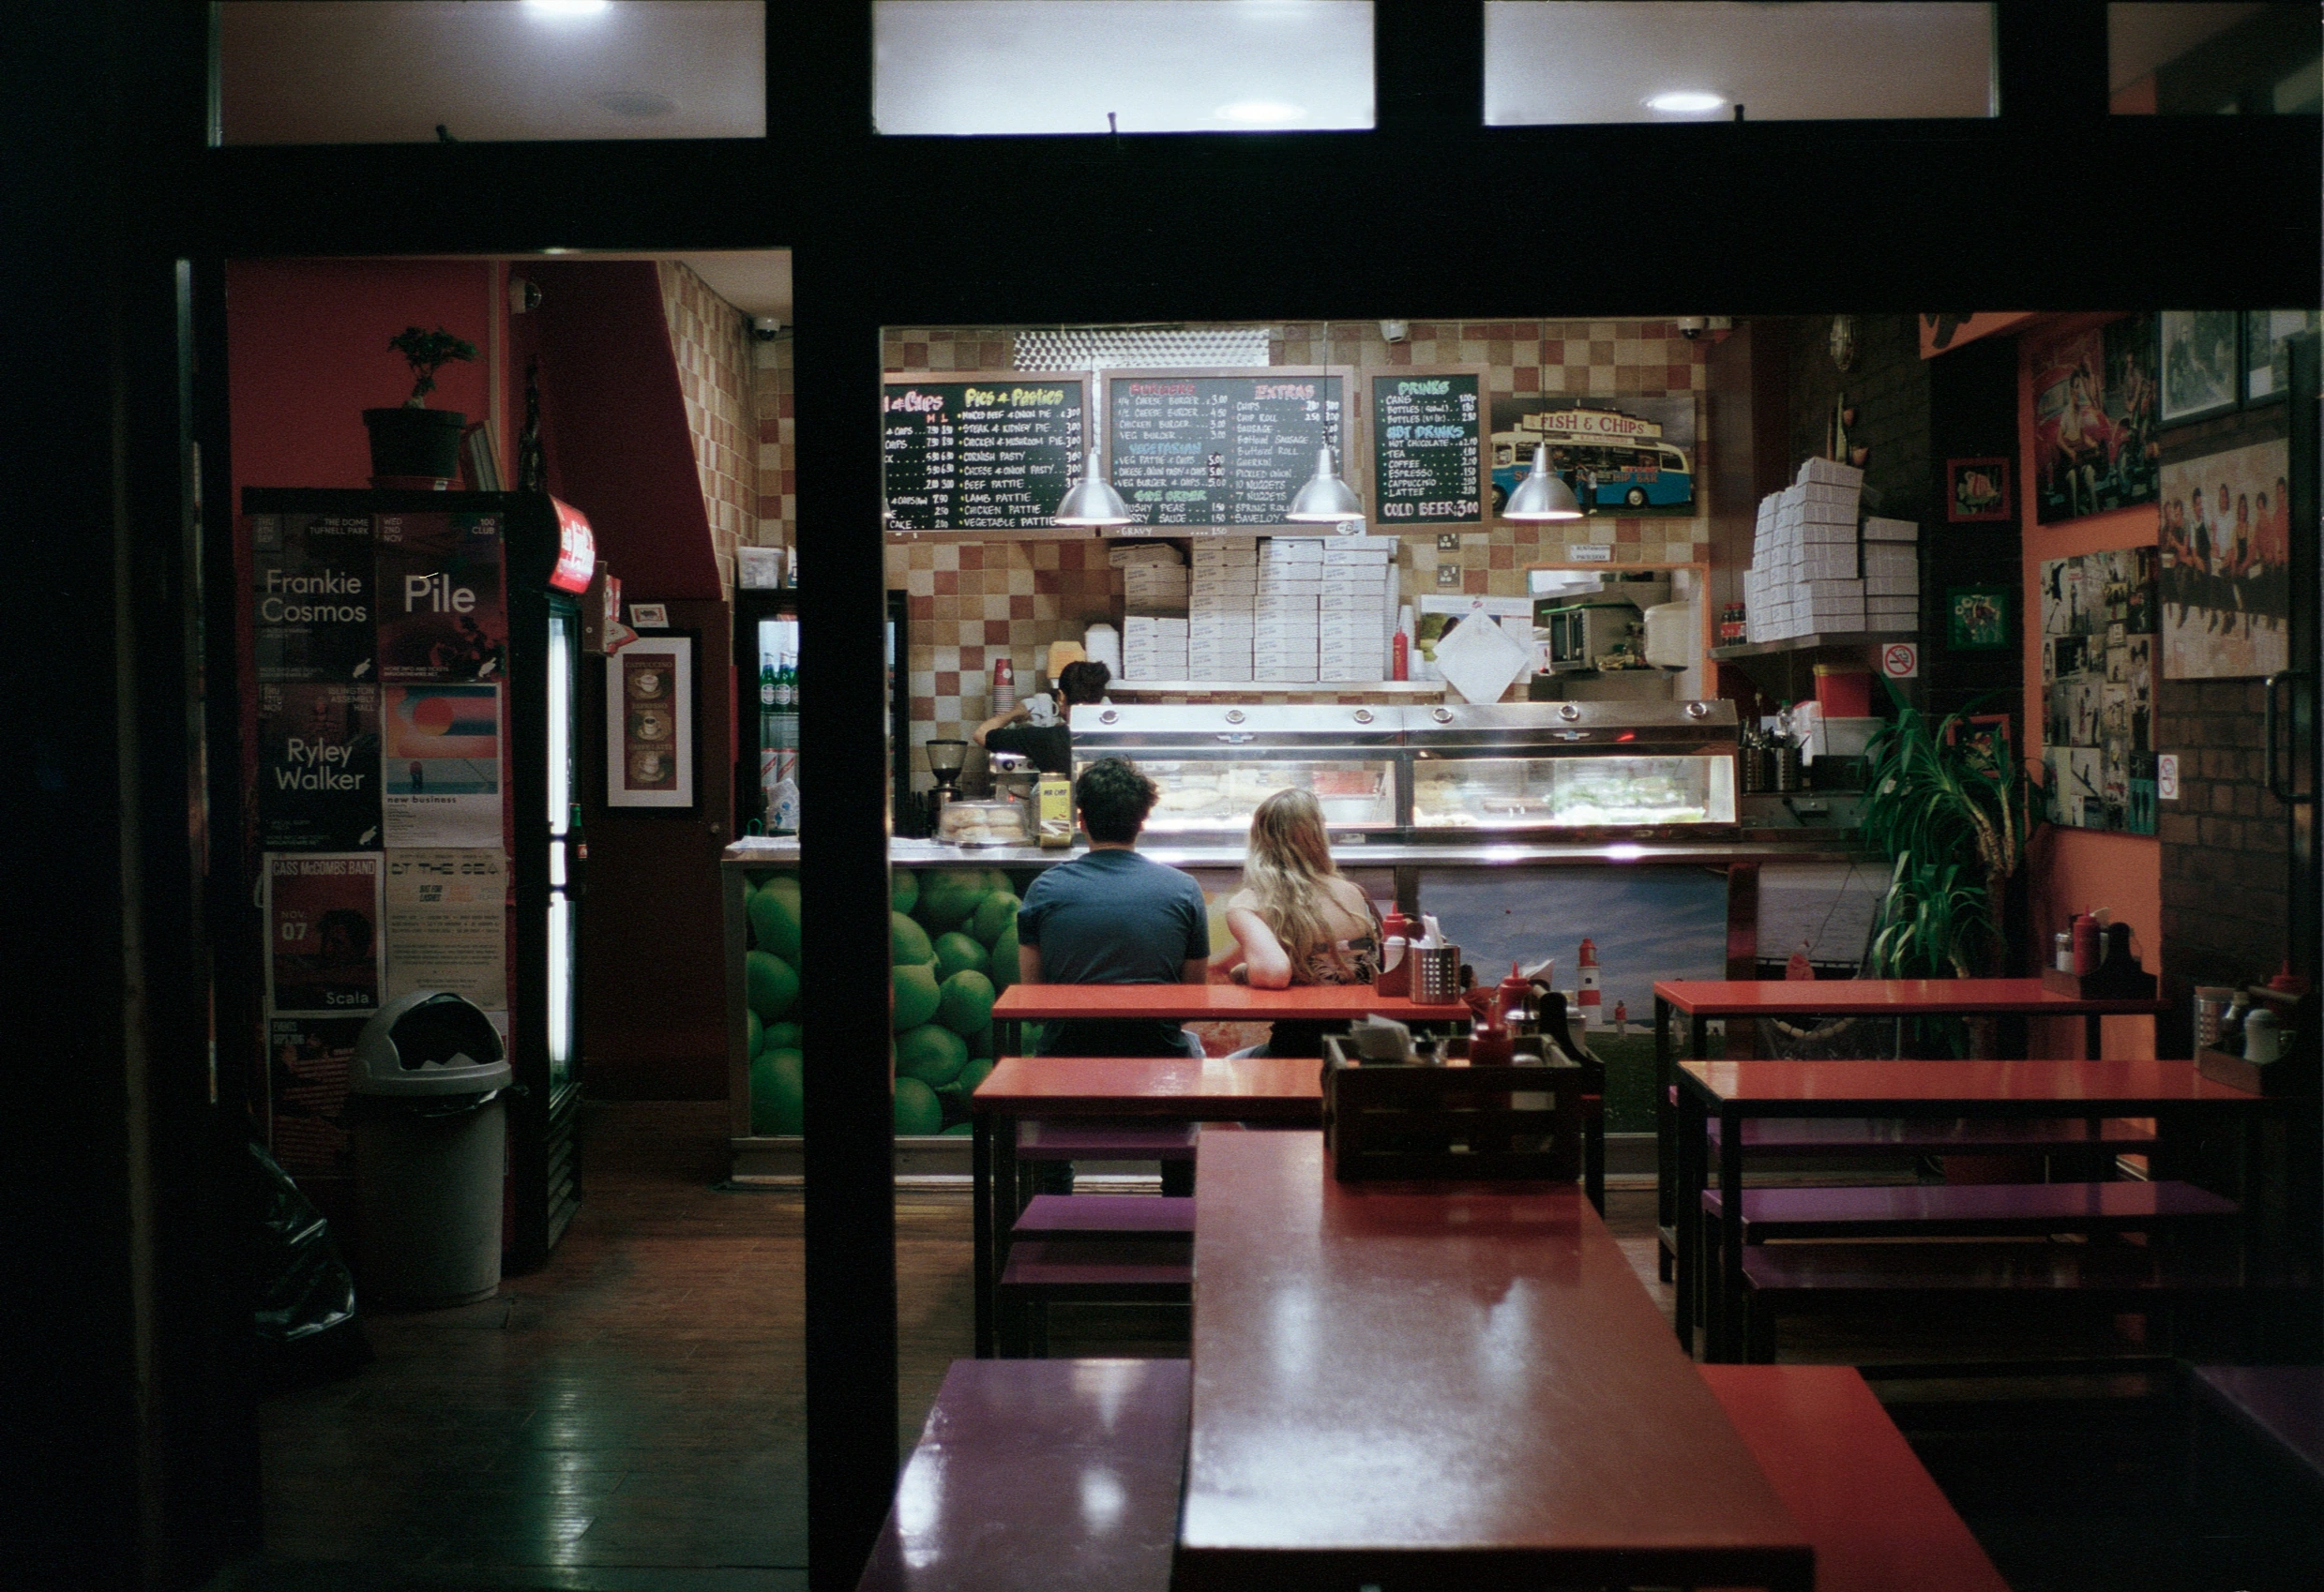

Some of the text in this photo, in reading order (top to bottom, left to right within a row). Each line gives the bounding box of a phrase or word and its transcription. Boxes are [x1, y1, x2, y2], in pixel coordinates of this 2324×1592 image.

[1129, 383, 1195, 397] BURGERS
[1255, 384, 1315, 401] EXTRAS
[1397, 381, 1450, 396] DRINKS
[1135, 396, 1163, 405] CHEESE
[1169, 396, 1200, 405] BURGER
[1386, 395, 1412, 405] CANS
[1236, 401, 1260, 411] CHIPS
[1387, 405, 1420, 414] BOTTLES
[927, 413, 949, 424] M L
[962, 409, 1052, 420] MINCED BEEF ONION PIE
[1135, 409, 1163, 418] CHEESE
[1236, 413, 1278, 422] CHIP ROLL
[1387, 414, 1420, 424] BOTTLES
[1540, 414, 1645, 434] FISH & CHIPS
[962, 424, 989, 433] STEAK
[1003, 423, 1032, 433] KIDNEY
[1035, 423, 1052, 433] PIE
[1119, 420, 1152, 429] CHICKEN
[1158, 420, 1191, 429] BURGER
[1236, 424, 1273, 433] SAUSAGE
[1120, 431, 1138, 441] VEG
[1386, 425, 1465, 441] HOT DRINKS
[963, 437, 995, 447] CHICKEN
[1005, 437, 1043, 446] MUSHROOM
[1049, 436, 1064, 445] PIE
[1275, 435, 1309, 444] SAUSAGE
[1388, 439, 1449, 448] HOT CHOCOLATE
[1129, 443, 1202, 456] VEGETARIAN
[1277, 446, 1298, 456] ROLL
[1386, 450, 1406, 458] TEA
[963, 451, 1026, 461] CORNISH PASTY
[1119, 456, 1135, 465] VEG
[1139, 456, 1167, 465] PATTIE
[1176, 456, 1195, 464] CHIPS
[1236, 458, 1272, 467] GHERKIN
[1388, 459, 1420, 469] COFFEE
[964, 465, 992, 476] CHEESE
[1004, 465, 1026, 474] ONION
[1030, 463, 1054, 474] PASTY
[1190, 467, 1206, 476] CHIPS
[1236, 469, 1292, 478] PICKLED ONION
[1388, 469, 1433, 478] ESPRESSO
[1117, 478, 1133, 488] VEG
[1137, 478, 1167, 488] BURGER
[1180, 478, 1200, 487] CHIPS
[1612, 473, 1658, 483] HIP BAR
[964, 478, 1024, 489] BEEF PATTIE
[1236, 480, 1286, 489] 10 NUGGETS
[964, 492, 1032, 503] LAMB PATTIE
[1134, 489, 1208, 503] SIDE ORDER
[1236, 491, 1287, 502] 7 NUGGETS
[1388, 488, 1426, 497] LATTEE
[964, 504, 1041, 516] CHICKEN PATTIE
[1159, 503, 1185, 513] PEAS
[1235, 503, 1266, 512] SPRING
[1384, 503, 1414, 517] COLD
[964, 517, 1056, 527] VEGETABLE PATTIE
[1159, 514, 1187, 523] SAUCE
[1234, 513, 1281, 523] SAVELOY
[889, 519, 912, 529] CAKE
[472, 526, 495, 534] CLUB
[1122, 527, 1153, 536] GRAVY
[384, 534, 403, 543] NOV
[266, 568, 362, 594] Frankie
[405, 574, 476, 614] Pile
[262, 597, 368, 623] Cosmos
[287, 737, 353, 768] Ryley
[275, 765, 365, 790] Walker
[413, 795, 457, 804] business
[272, 861, 376, 876] CASS McCOMBS BAND
[418, 863, 454, 874] THE
[281, 922, 308, 941] 07
[324, 990, 370, 1005] Scala
